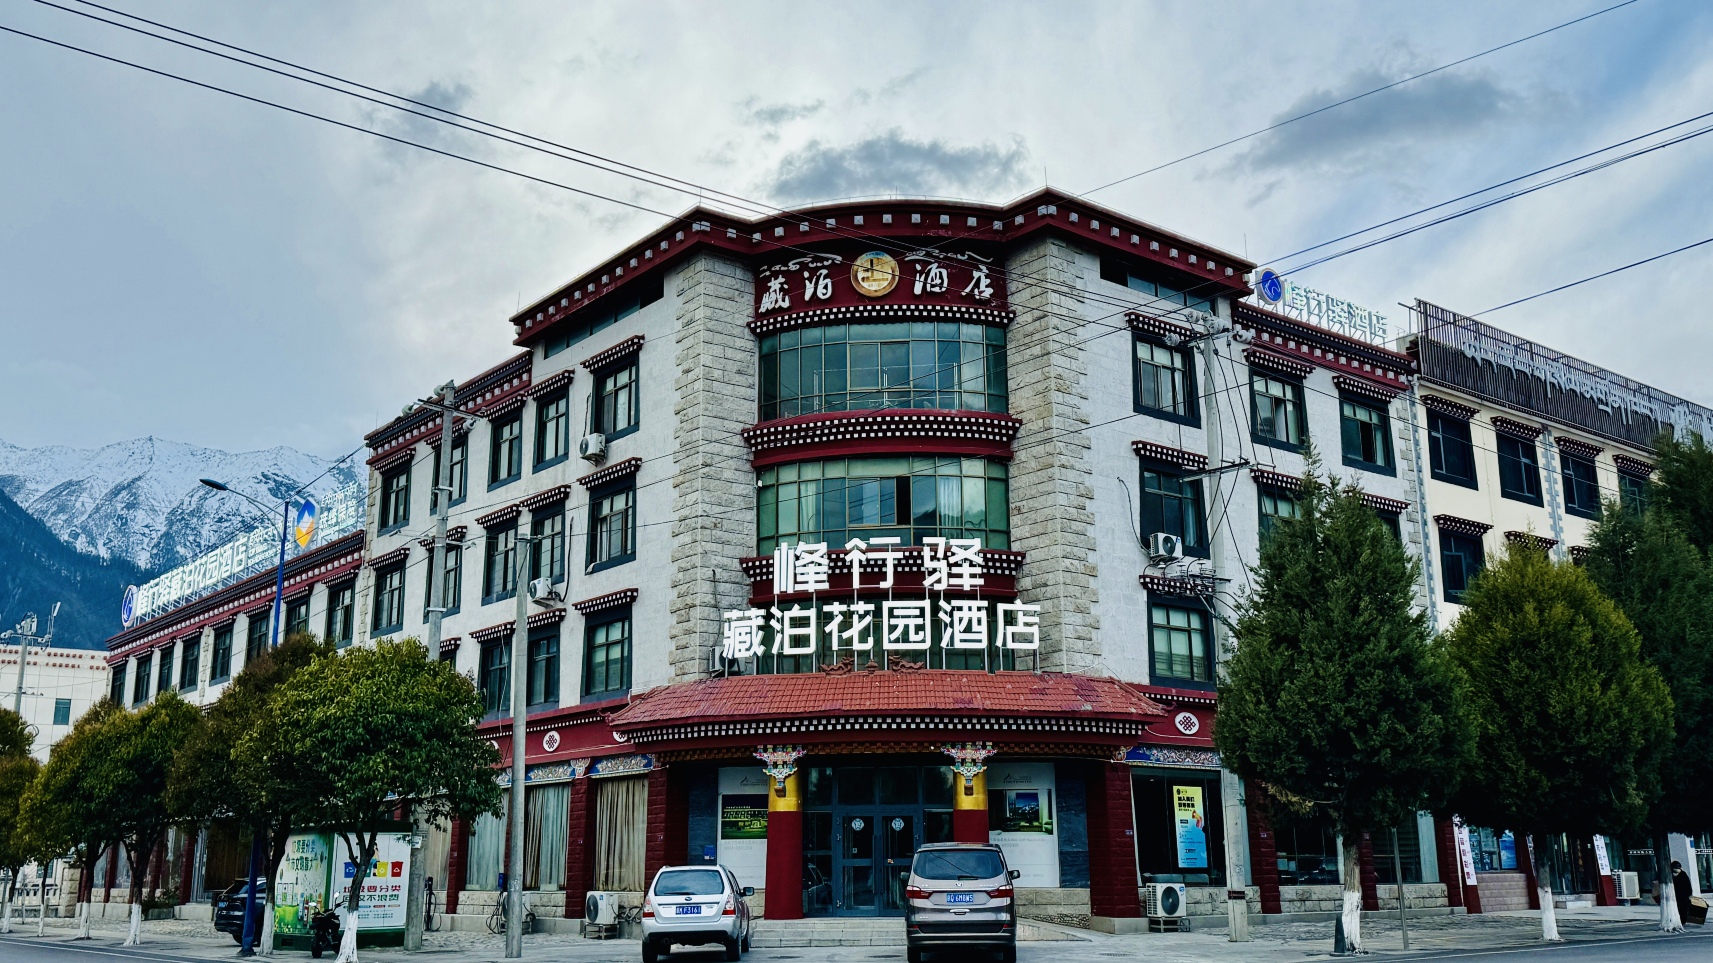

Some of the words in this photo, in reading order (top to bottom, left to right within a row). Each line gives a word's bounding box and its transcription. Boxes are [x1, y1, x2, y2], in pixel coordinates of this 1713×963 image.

[913, 263, 994, 300] 酒店
[773, 536, 985, 594] 峰行驿
[722, 599, 1041, 659] 藏泊花园酒店
